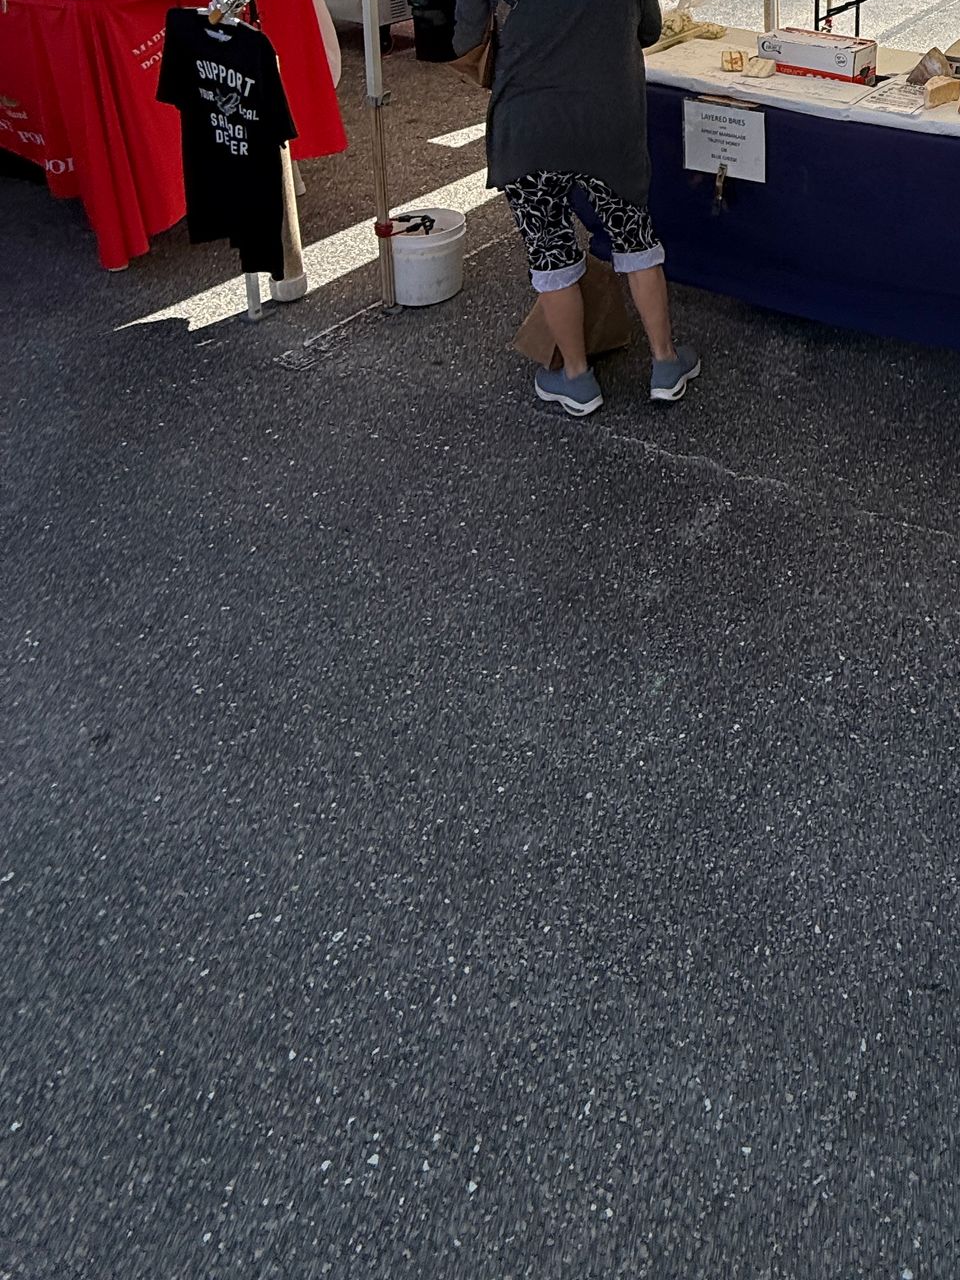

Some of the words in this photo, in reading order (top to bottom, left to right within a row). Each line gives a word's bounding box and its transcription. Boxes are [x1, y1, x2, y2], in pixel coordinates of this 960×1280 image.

[196, 60, 255, 97] SUPPORT
[701, 113, 727, 123] LAYERED
[729, 118, 745, 127] BRIES
